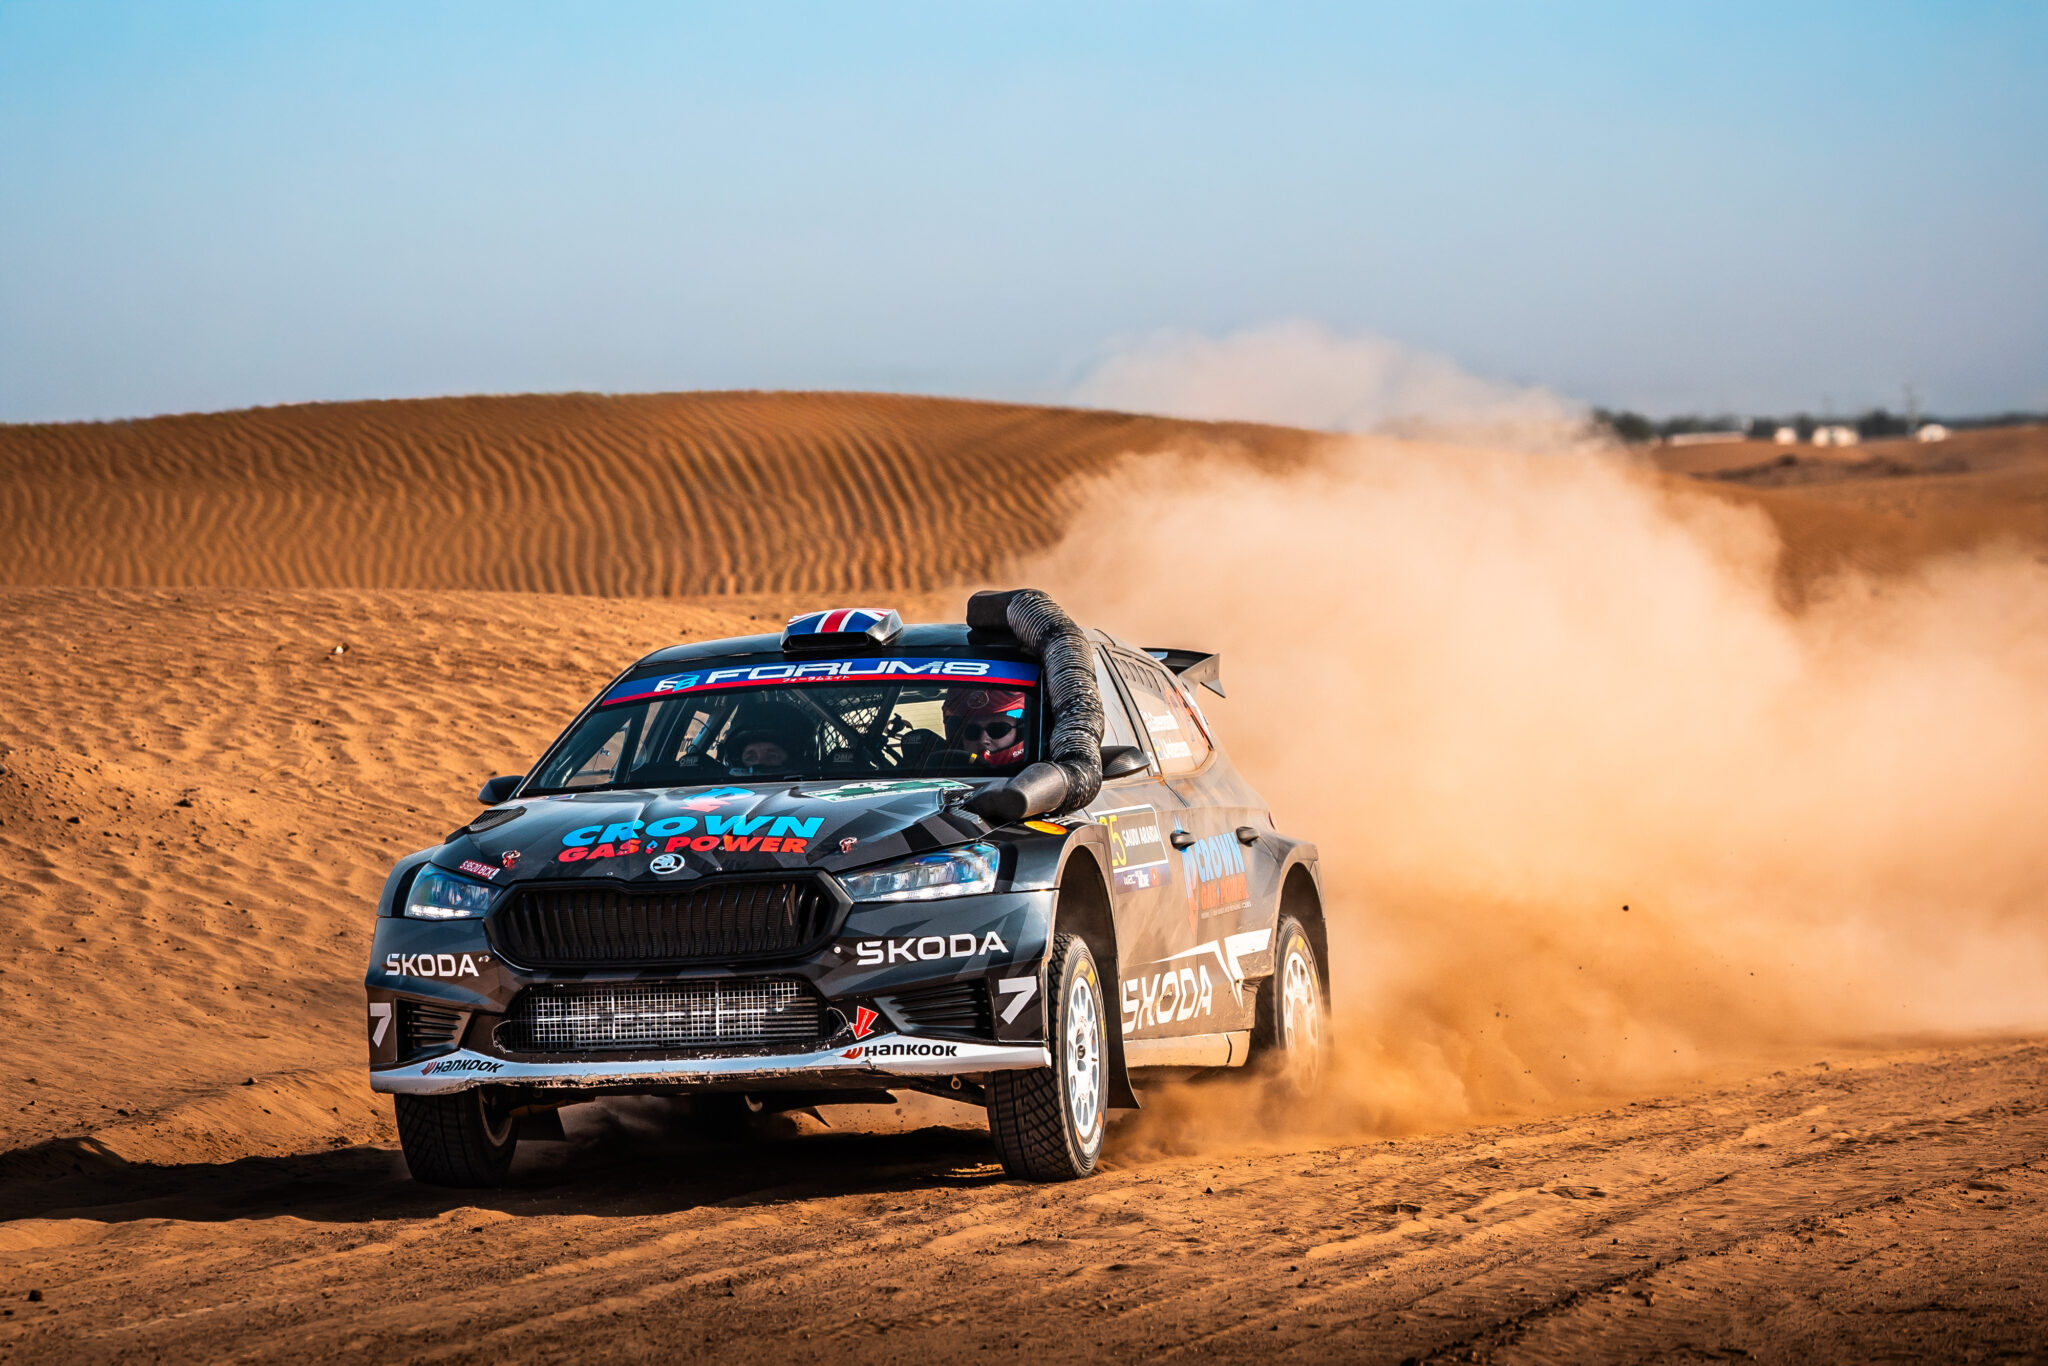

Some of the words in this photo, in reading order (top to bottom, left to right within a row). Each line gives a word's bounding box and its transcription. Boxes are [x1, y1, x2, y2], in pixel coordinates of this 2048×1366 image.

[705, 661, 991, 684] FORUM8
[558, 838, 641, 863] GAS
[664, 835, 808, 855] POWER
[561, 815, 825, 847] CROWN
[1193, 831, 1245, 883] CROWN
[998, 976, 1038, 1025] 7
[369, 1002, 392, 1048] 7
